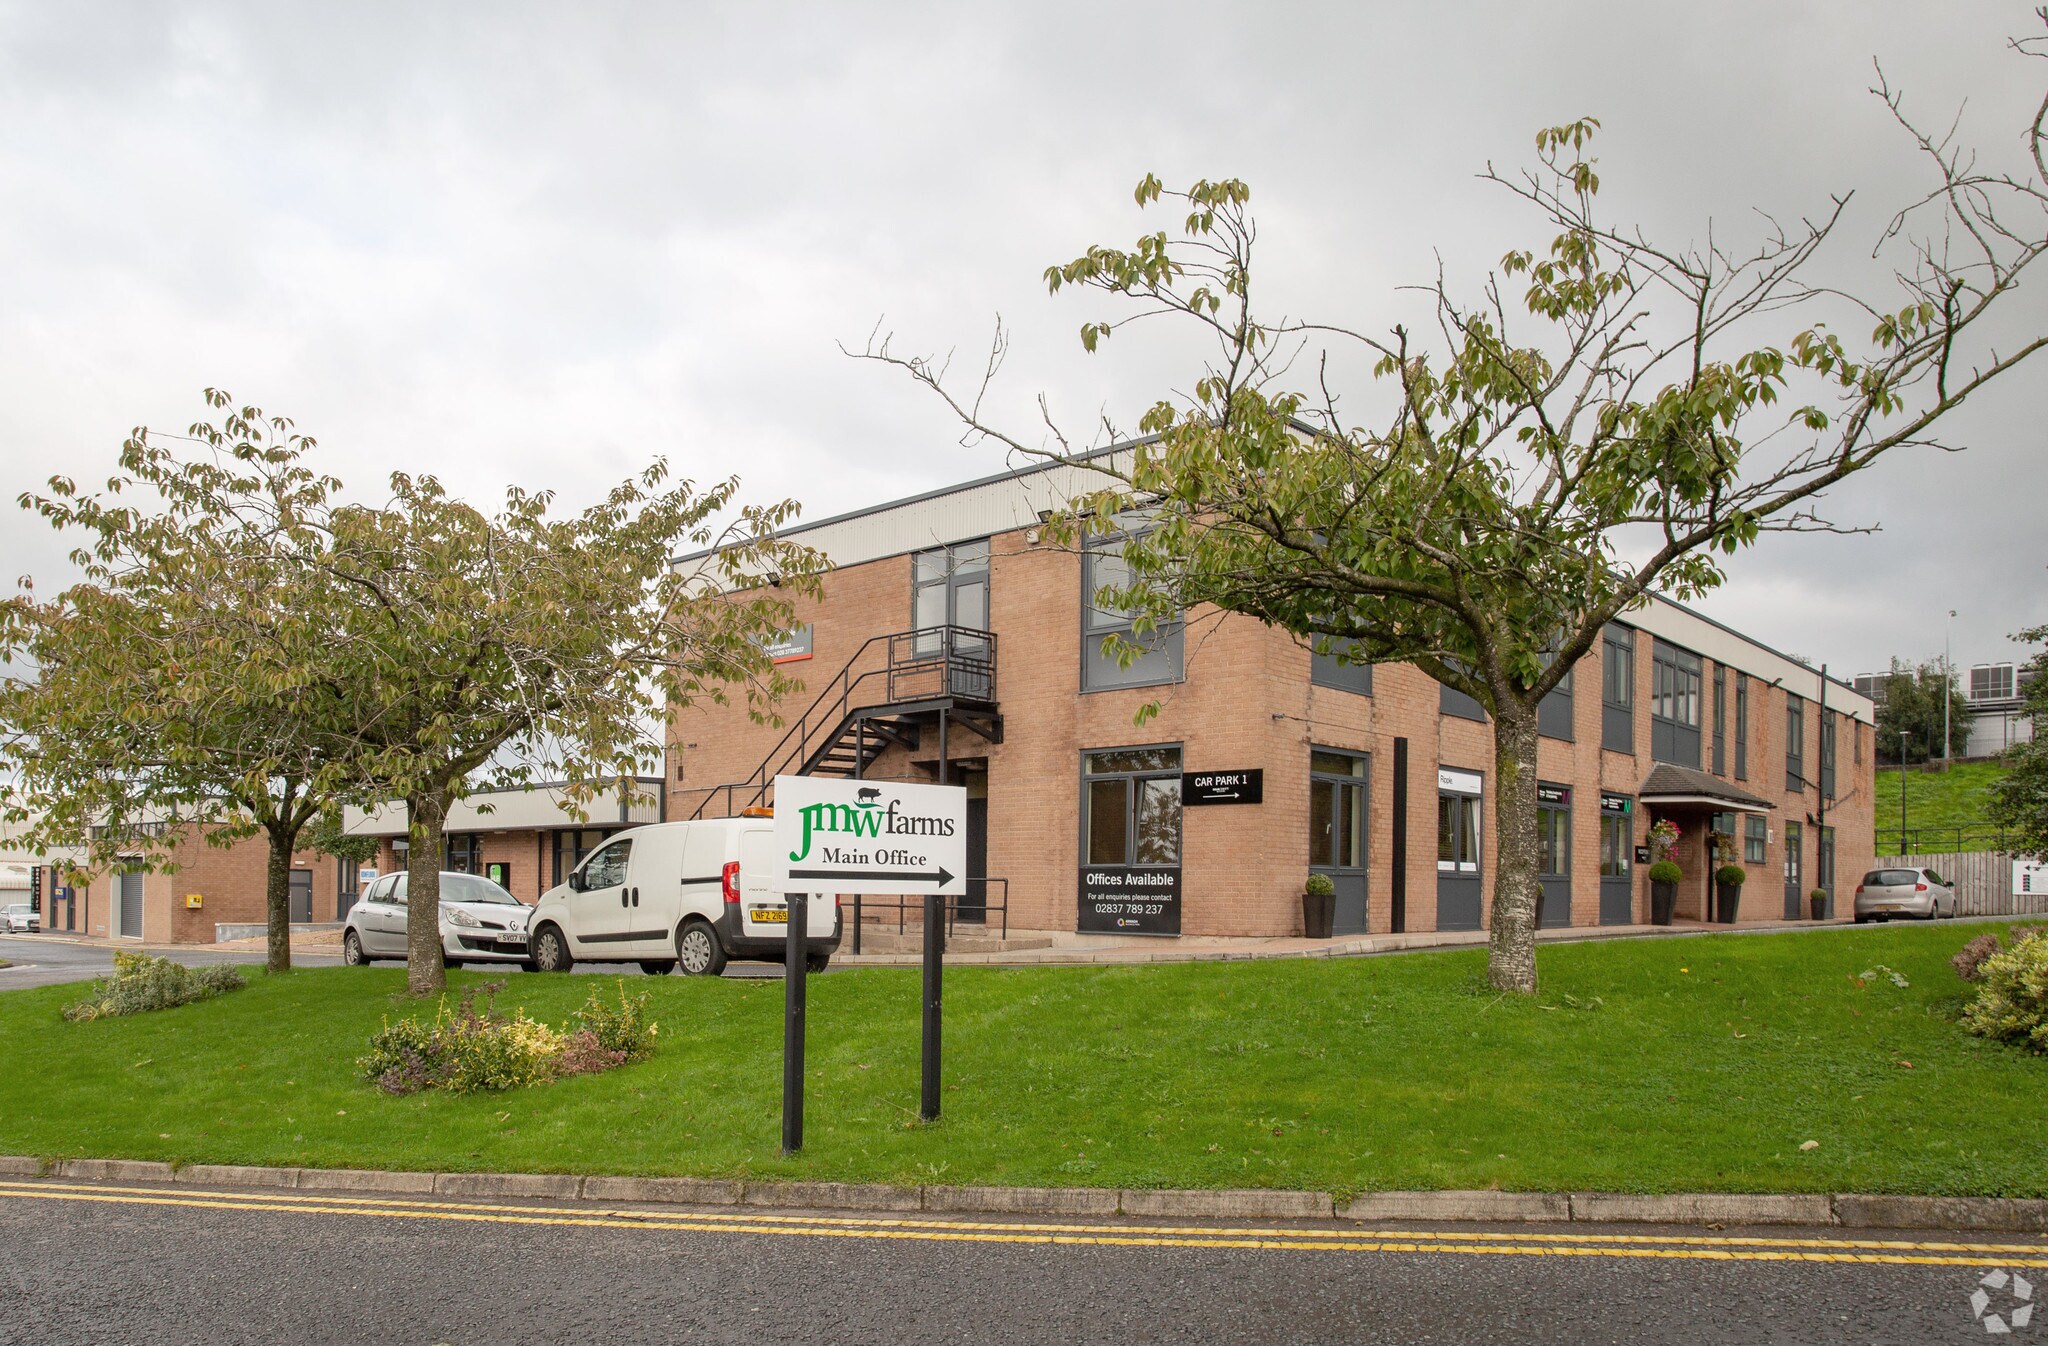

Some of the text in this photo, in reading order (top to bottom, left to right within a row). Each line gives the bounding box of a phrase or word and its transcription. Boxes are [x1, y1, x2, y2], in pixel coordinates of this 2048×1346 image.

[1195, 774, 1247, 787] CAR PARK 1
[822, 848, 927, 866] Main Office
[1086, 873, 1174, 886] Offices Available
[1087, 892, 1096, 900] For
[1105, 893, 1131, 901] enquiries
[1131, 893, 1150, 902] please
[1150, 894, 1173, 902] contact
[1095, 903, 1163, 915] 02837 789 237
[755, 911, 770, 920] NFZ
